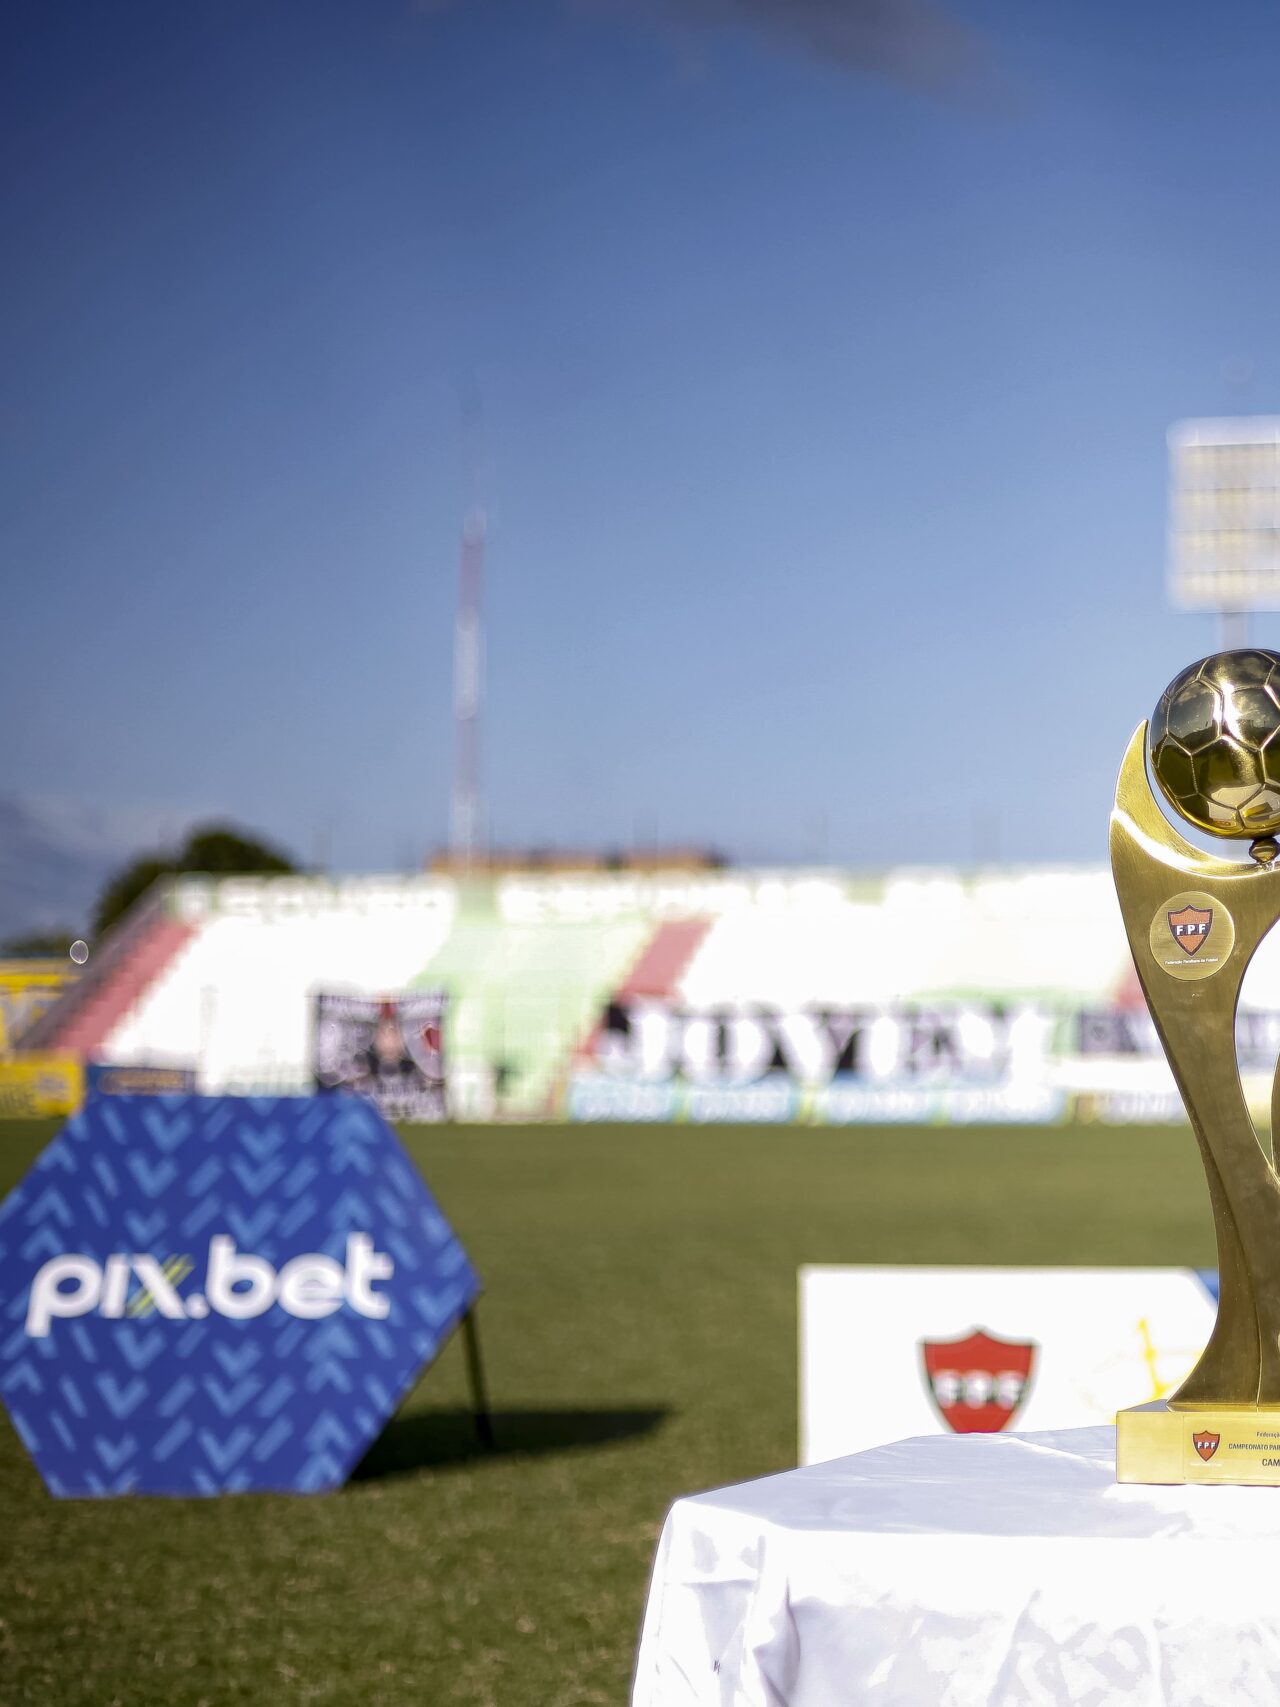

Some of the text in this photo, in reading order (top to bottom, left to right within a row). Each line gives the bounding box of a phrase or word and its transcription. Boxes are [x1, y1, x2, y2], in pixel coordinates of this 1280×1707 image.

[1176, 923, 1206, 936] FPF
[24, 1230, 394, 1338] pix.bet
[1197, 1441, 1216, 1450] FPF
[1228, 1443, 1269, 1451] CAMPEONATO
